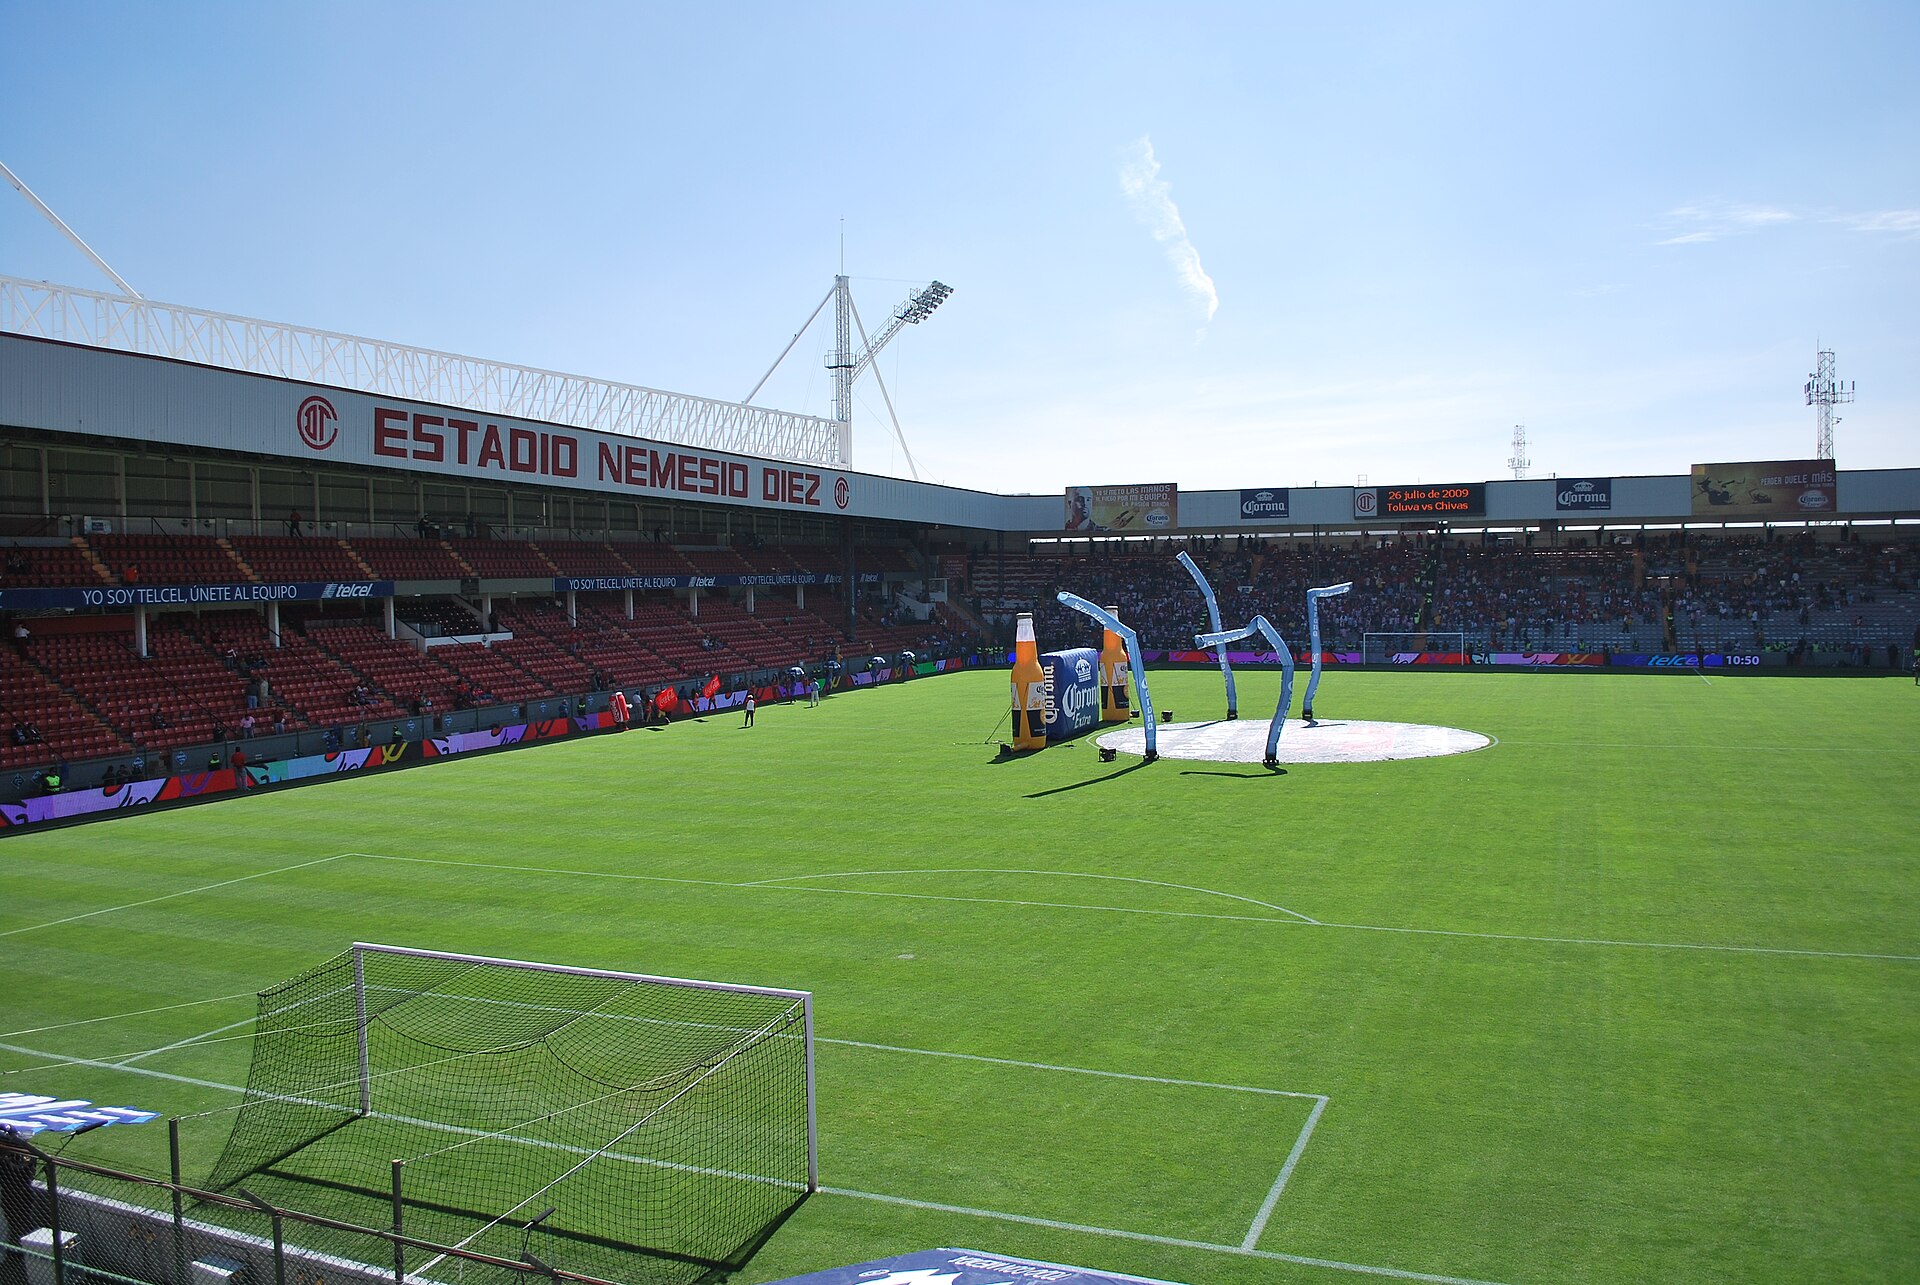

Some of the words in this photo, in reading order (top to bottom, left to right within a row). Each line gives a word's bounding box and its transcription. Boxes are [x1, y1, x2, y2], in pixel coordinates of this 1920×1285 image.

[374, 407, 578, 478] ESTADIO
[598, 441, 749, 499] NEMESIO
[762, 466, 821, 506] DIEZ
[1784, 474, 1808, 484] DUELE
[1126, 487, 1139, 495] LAS
[1140, 484, 1171, 493] MANOS
[1388, 491, 1402, 501] 26
[1403, 489, 1426, 501] julio
[1428, 488, 1440, 499] de
[1442, 488, 1469, 499] 2009
[1557, 490, 1607, 507] Corona
[1800, 496, 1826, 504] Corona
[1242, 500, 1285, 515] Corona
[1421, 503, 1433, 511] vs
[1435, 500, 1469, 511] Chivas
[1146, 514, 1168, 523] Corona
[568, 579, 580, 590] YO
[580, 578, 596, 590] SOY
[596, 578, 621, 590] TELCEL,
[621, 576, 643, 589] ÚNETE
[644, 578, 652, 588] AL
[653, 577, 676, 588] EQUIPO
[695, 576, 716, 587] telcel
[82, 590, 104, 605] YO
[107, 589, 134, 605] SOY
[137, 587, 188, 604] TELCEL,
[190, 585, 231, 602] ÚNETE
[234, 586, 249, 600] AL
[252, 585, 297, 601] EQUIPO
[335, 583, 371, 598] telcel
[1727, 655, 1760, 666] 10:50
[1044, 664, 1060, 724] Corona
[1073, 713, 1092, 730] Extra
